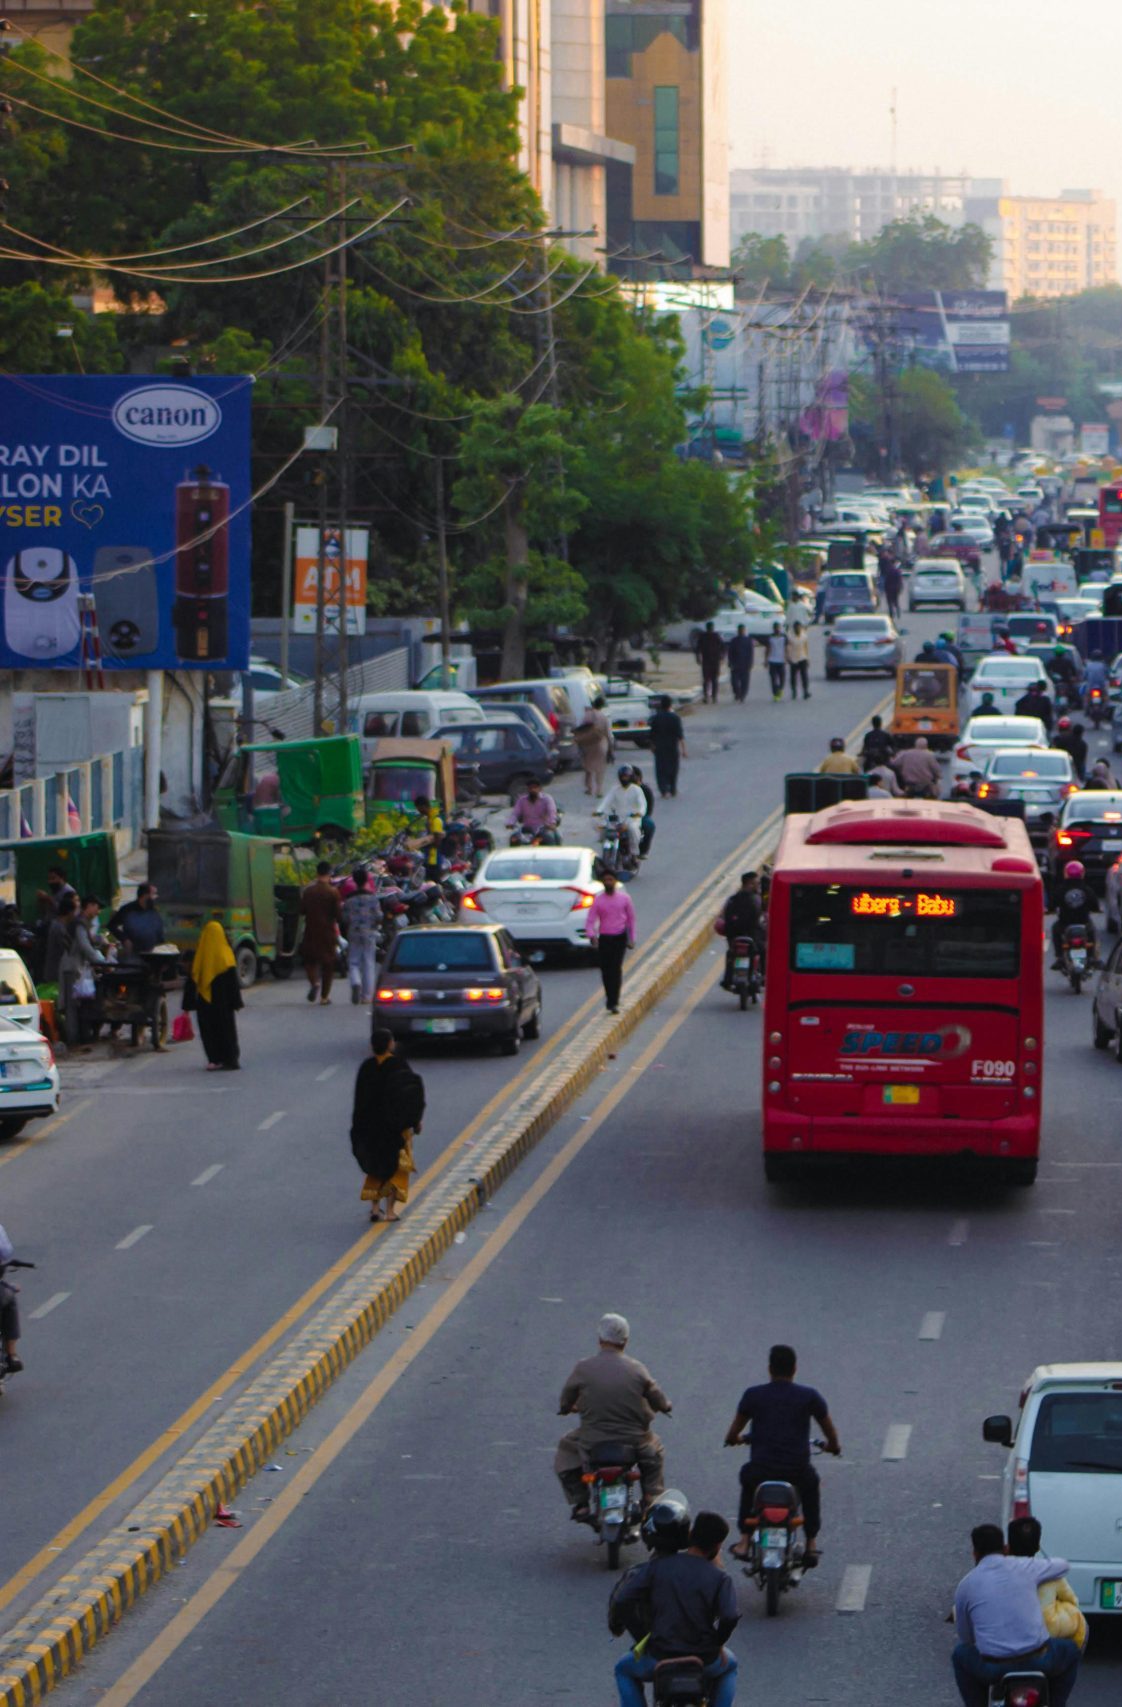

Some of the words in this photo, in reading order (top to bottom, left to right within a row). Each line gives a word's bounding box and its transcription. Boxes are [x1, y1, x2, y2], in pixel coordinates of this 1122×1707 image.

[125, 405, 208, 427] canon
[59, 444, 109, 467] DIL
[0, 473, 63, 498] LON
[72, 473, 112, 499] KA
[302, 565, 361, 592] ATM
[916, 893, 955, 915] Babu
[970, 1059, 1016, 1077] F090
